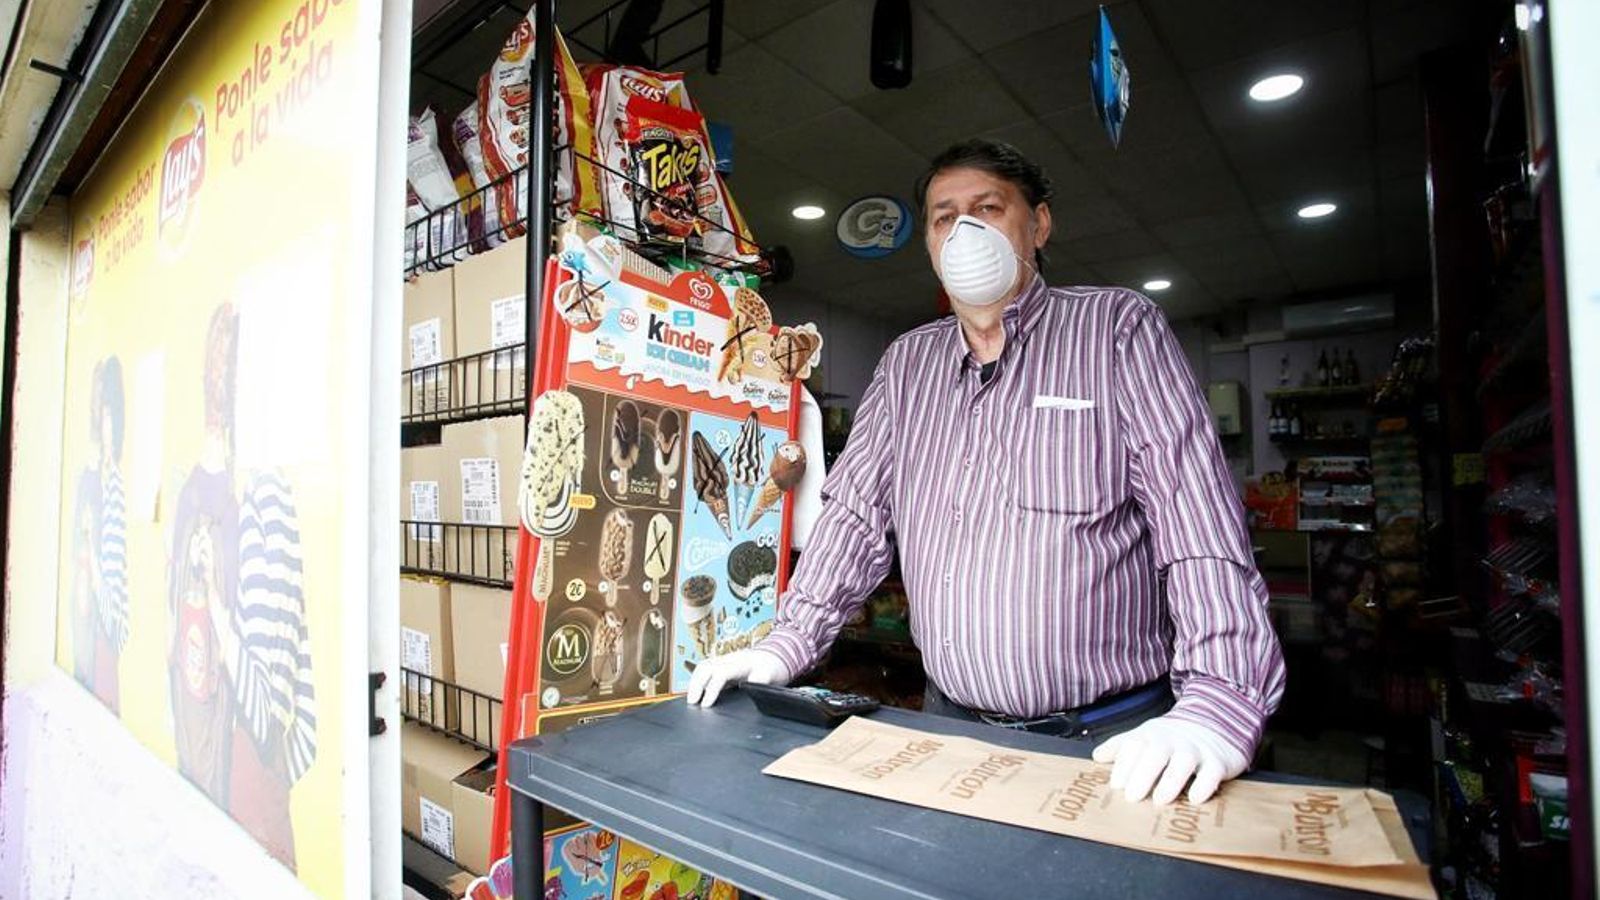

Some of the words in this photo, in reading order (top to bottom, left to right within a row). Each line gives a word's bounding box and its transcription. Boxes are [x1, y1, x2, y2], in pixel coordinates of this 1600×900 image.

[215, 42, 273, 133] Ponle
[232, 128, 244, 167] a
[250, 102, 270, 152] la
[275, 40, 333, 122] vida
[622, 76, 668, 101] Lay's
[125, 162, 156, 218] sabor
[642, 143, 699, 192] Takis
[569, 583, 582, 597] 2€
[557, 634, 581, 659] M
